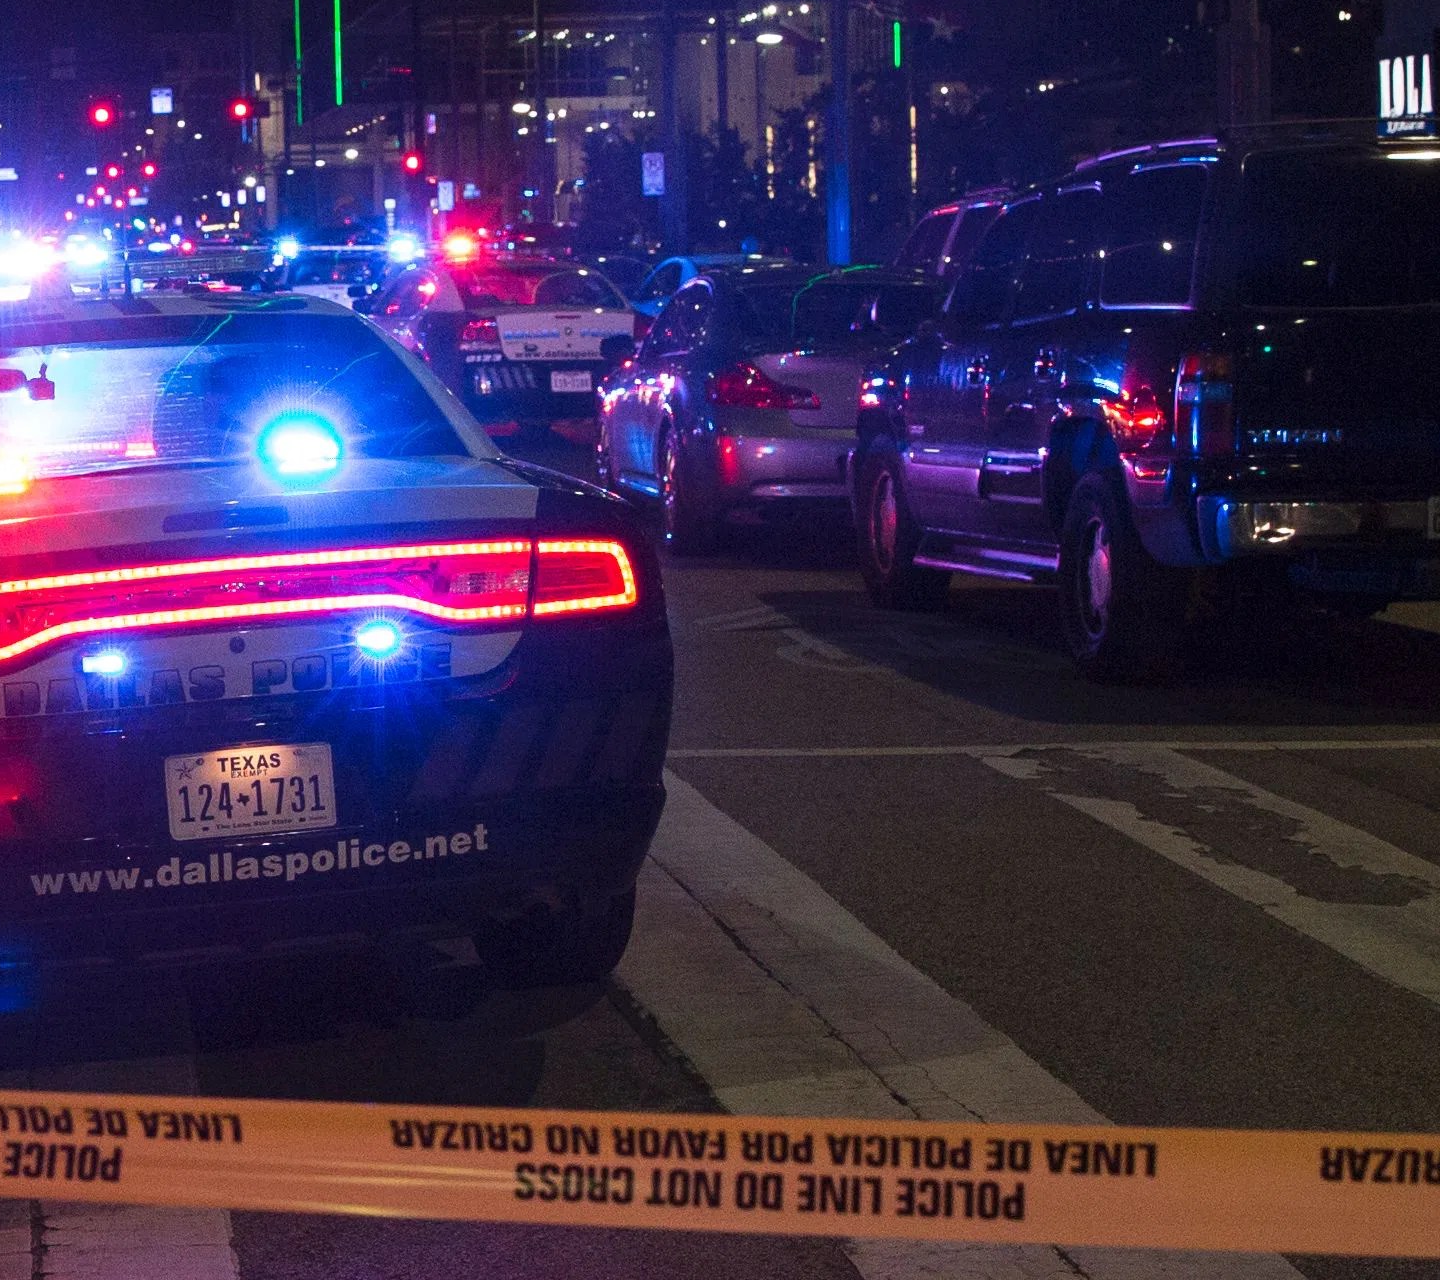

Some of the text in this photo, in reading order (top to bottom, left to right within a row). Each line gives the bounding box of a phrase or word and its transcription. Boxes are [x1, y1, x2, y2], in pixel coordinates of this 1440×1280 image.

[3, 664, 226, 717] DALLAS
[217, 753, 281, 773] TEXAS
[230, 769, 268, 779] EXEMPT
[30, 823, 490, 897] www.dallaspolice.net
[85, 1109, 128, 1136] DE
[140, 1110, 242, 1142] LINEA
[3, 1140, 123, 1182] POLICE
[391, 1119, 1158, 1177] LINEA DE POLICIA POR FAVOR NO CRUZAR
[514, 1163, 1025, 1220] POLICE LINE DO NOT CROSS
